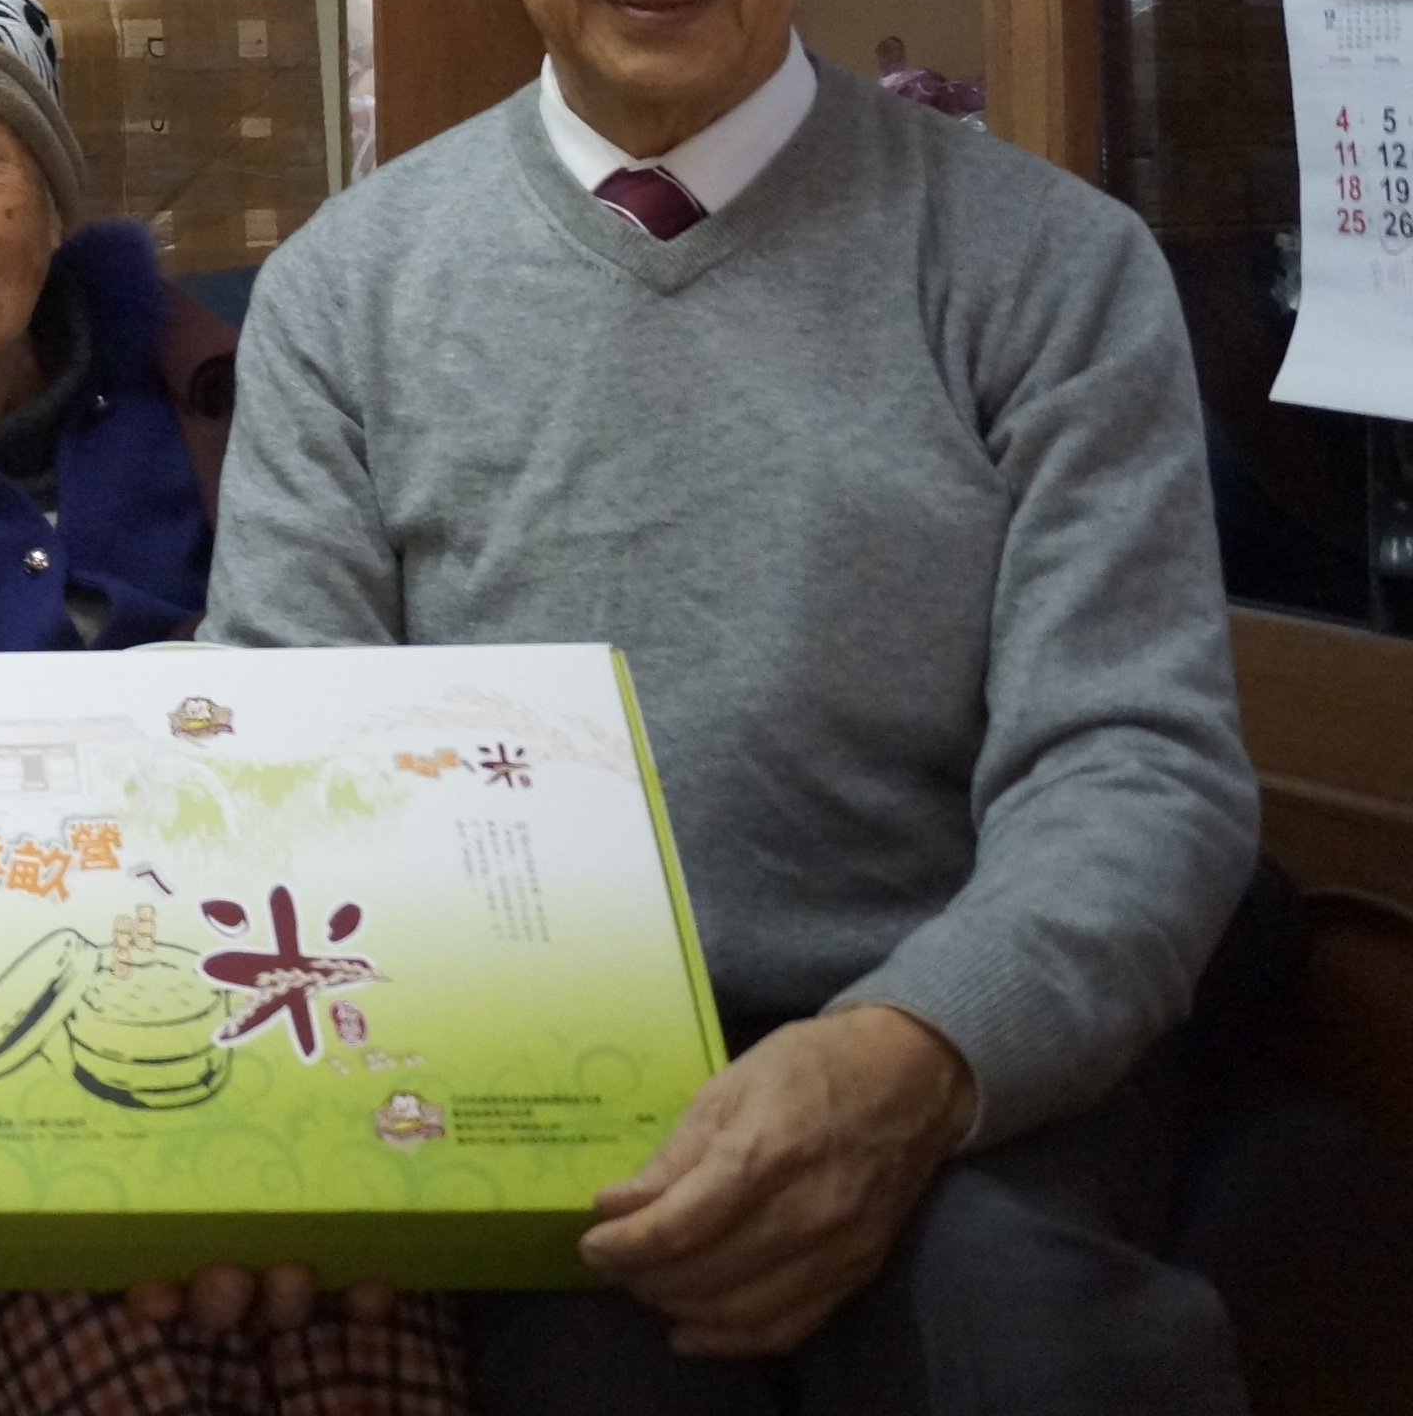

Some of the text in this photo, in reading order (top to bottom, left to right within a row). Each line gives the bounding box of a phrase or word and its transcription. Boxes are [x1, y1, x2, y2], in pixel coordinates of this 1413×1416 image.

[1334, 105, 1398, 134] 4 5
[1334, 139, 1409, 170] 11 12
[1335, 173, 1411, 204] 18 19
[1336, 207, 1413, 238] 25 26
